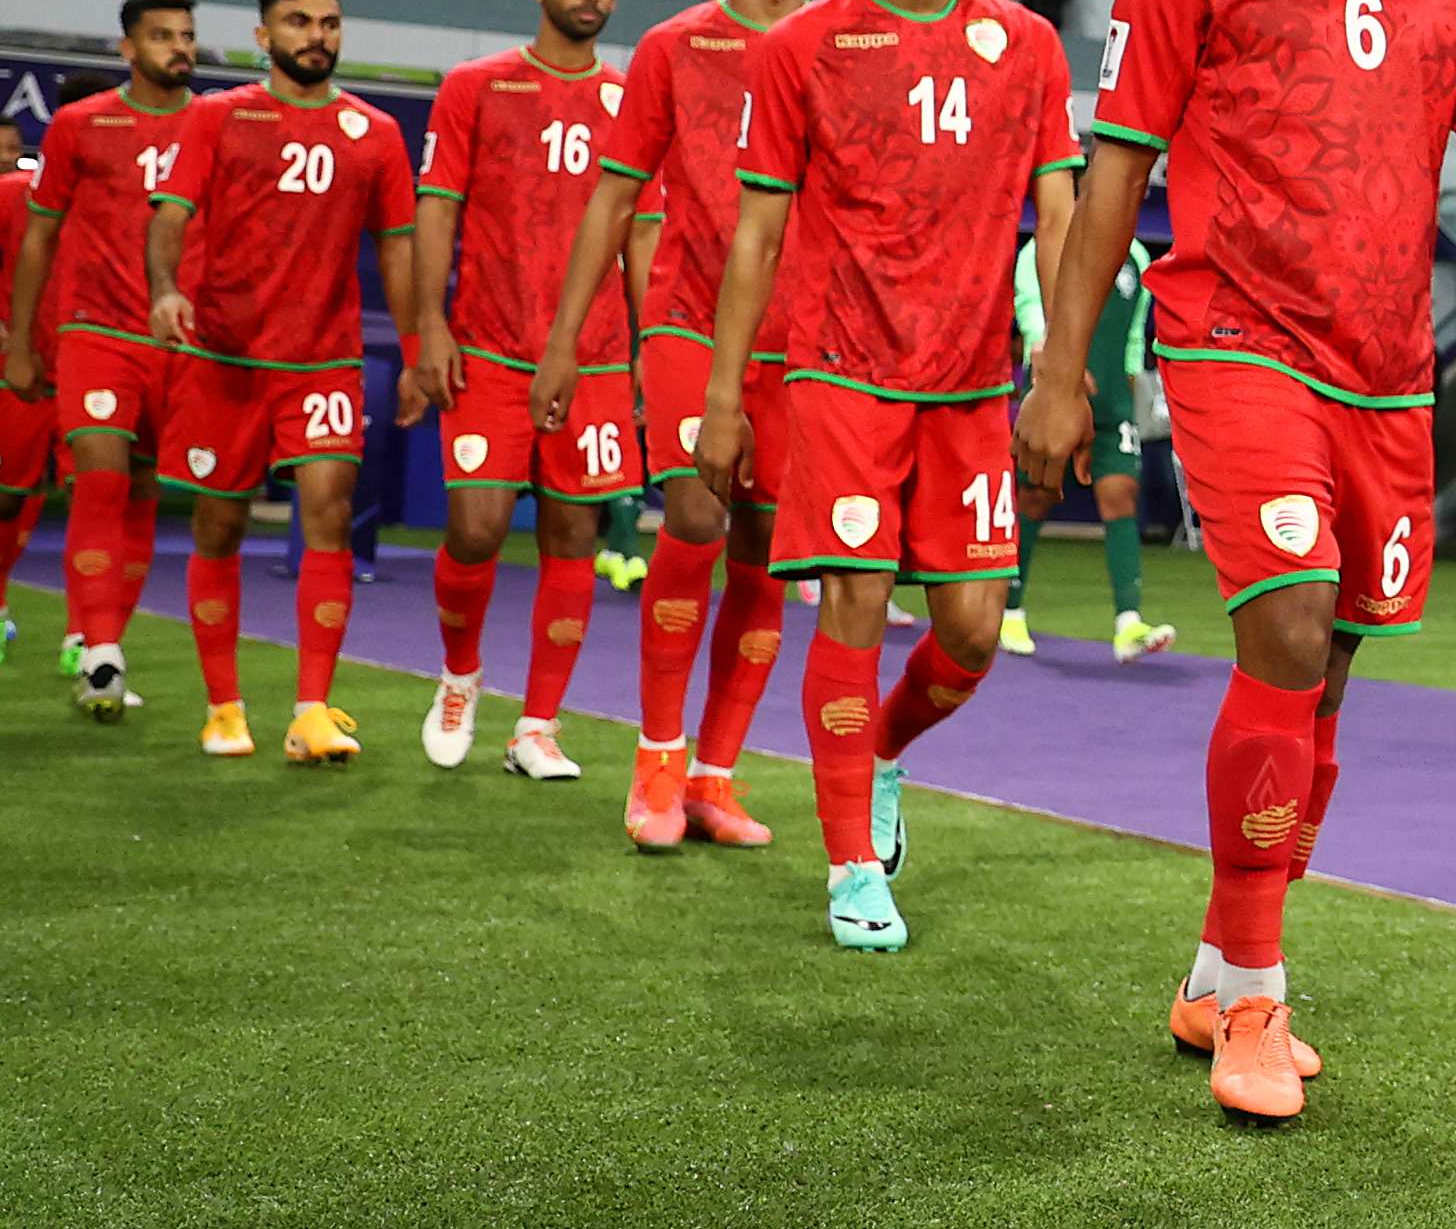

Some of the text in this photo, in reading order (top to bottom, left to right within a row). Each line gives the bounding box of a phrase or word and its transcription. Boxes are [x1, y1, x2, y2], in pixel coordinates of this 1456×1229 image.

[908, 76, 972, 144] 14
[277, 142, 335, 194] 20
[540, 120, 592, 176] 16
[303, 391, 354, 440] 20
[577, 421, 622, 477] 16
[962, 470, 1016, 542] 14
[1381, 515, 1411, 598] 6
